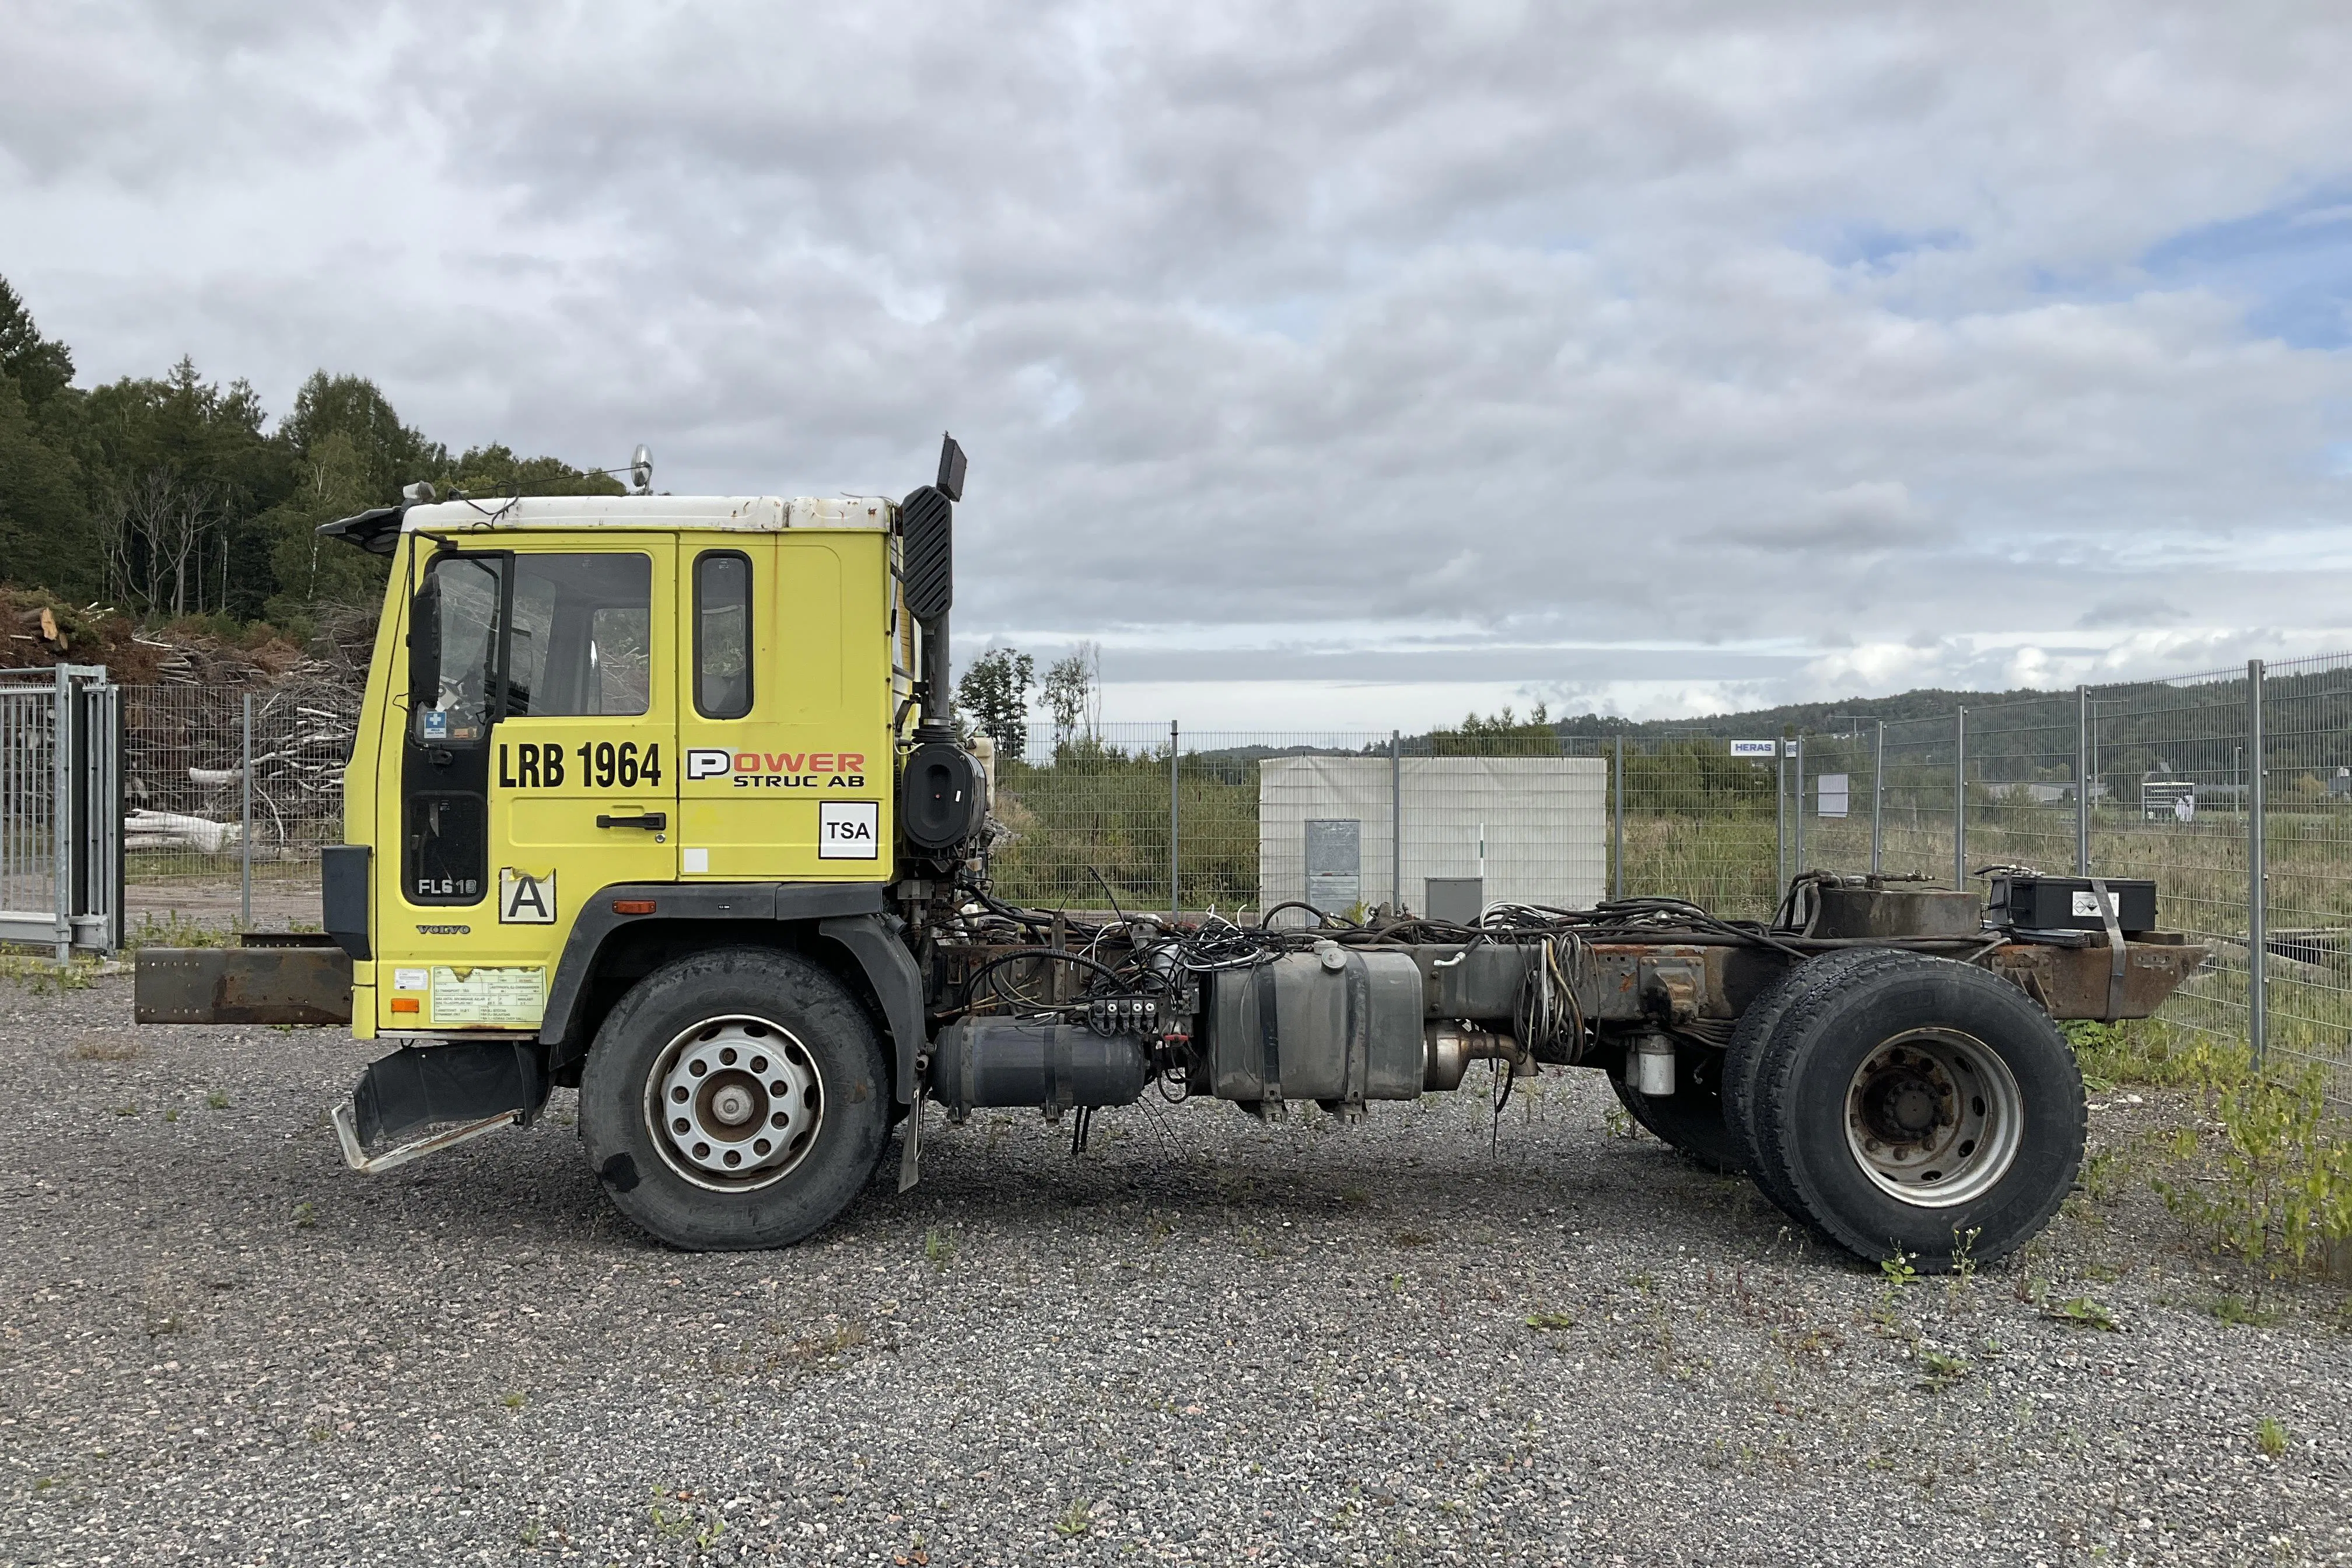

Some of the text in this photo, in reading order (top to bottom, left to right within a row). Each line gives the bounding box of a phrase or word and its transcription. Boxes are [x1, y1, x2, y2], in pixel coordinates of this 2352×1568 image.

[499, 741, 662, 788] LRB 1964
[687, 750, 864, 780] POWER
[734, 775, 864, 787] STRUC AB
[827, 822, 871, 839] TSA
[508, 877, 548, 918] A
[416, 925, 471, 935] VOLVO
